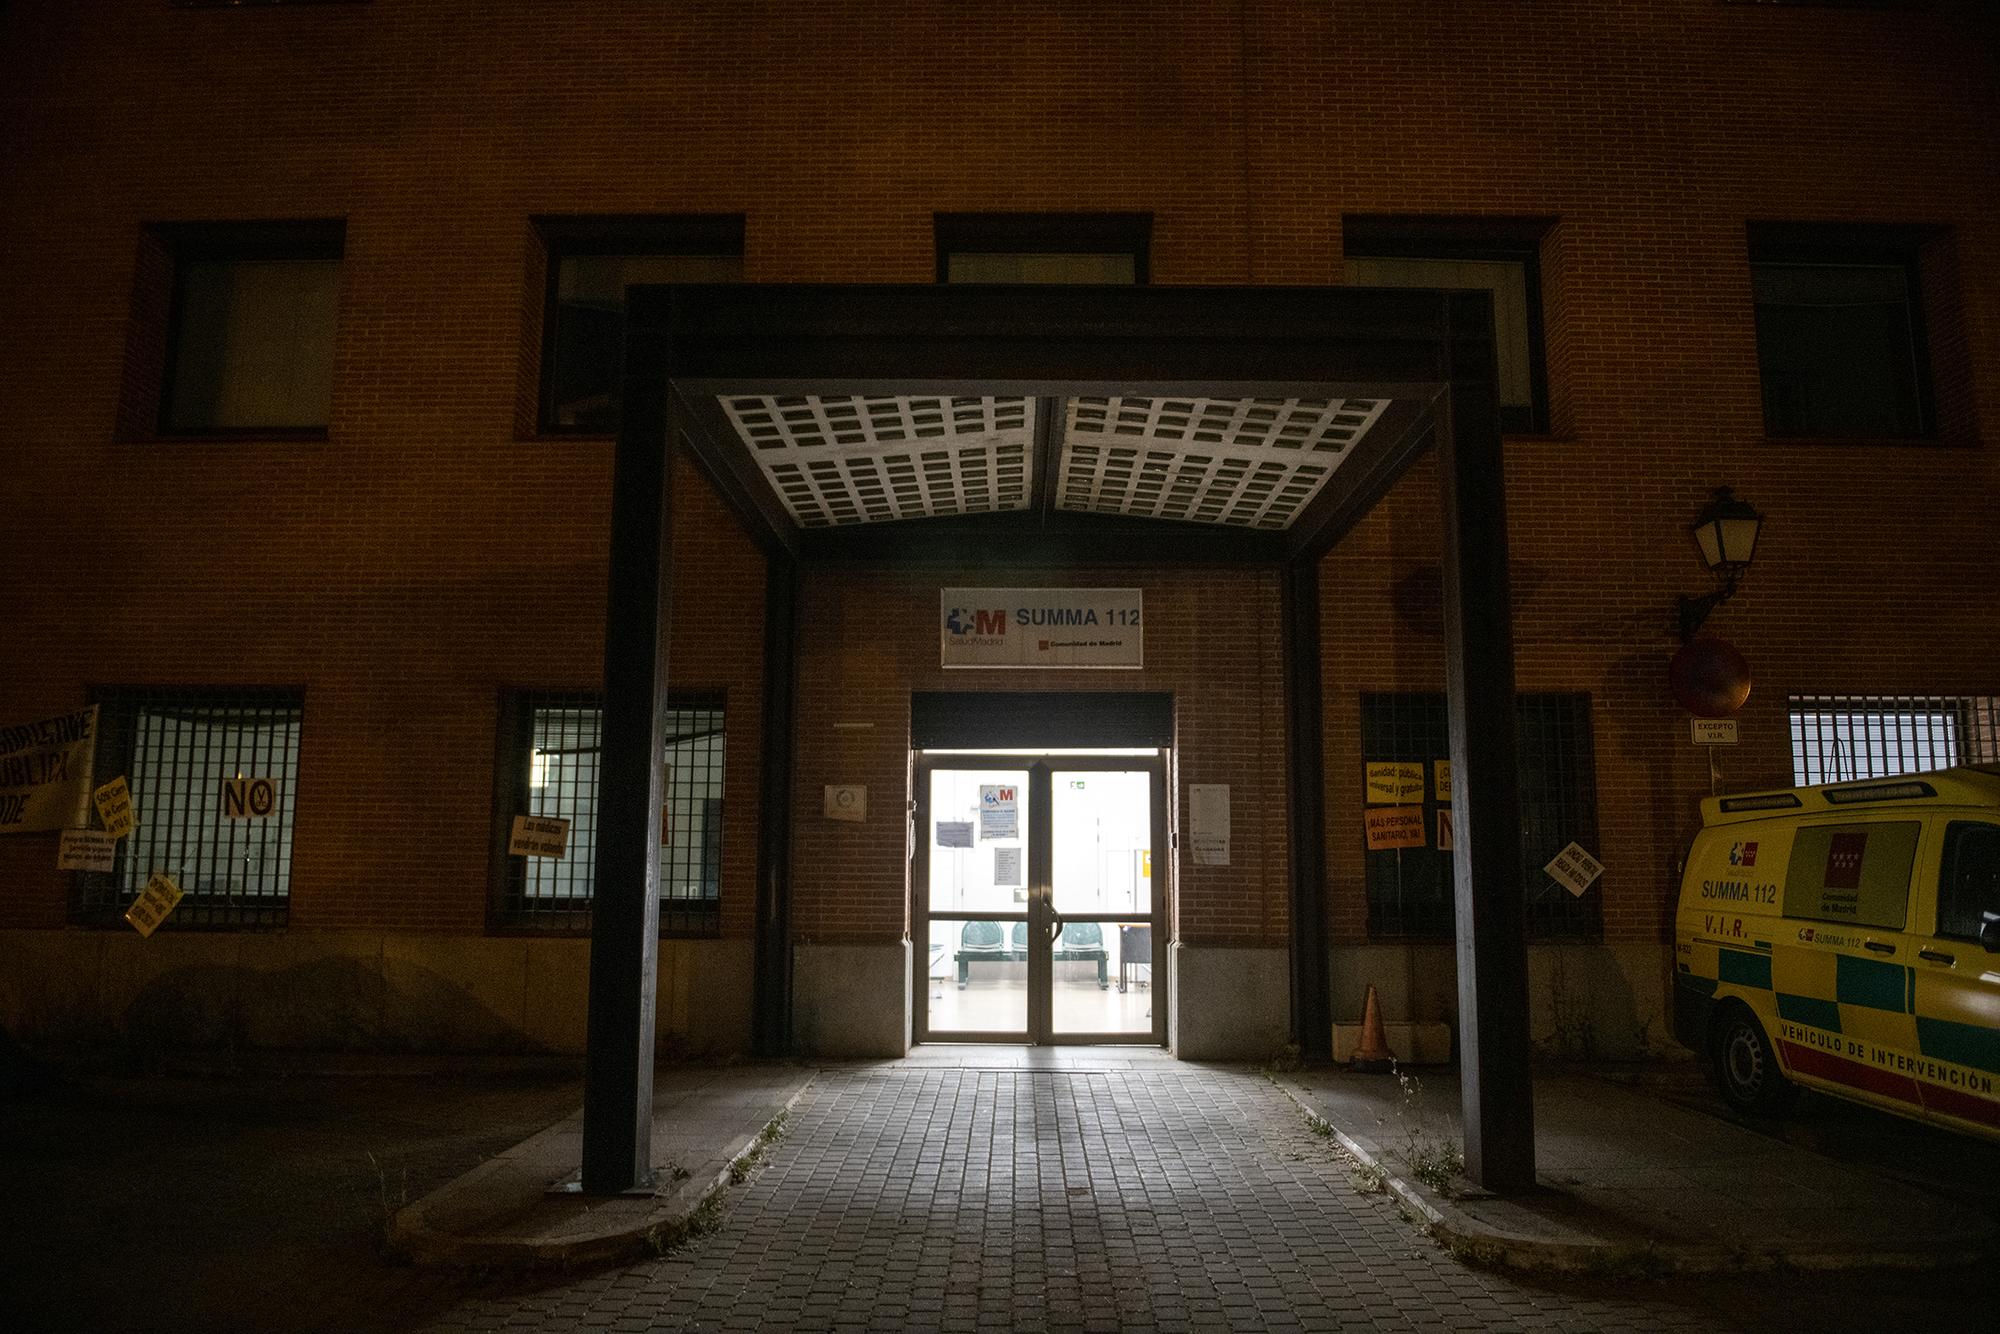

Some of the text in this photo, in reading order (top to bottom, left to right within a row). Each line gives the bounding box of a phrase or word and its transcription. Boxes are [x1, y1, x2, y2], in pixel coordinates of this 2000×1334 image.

[1016, 608, 1140, 626] SUMMA 112
[1050, 640, 1088, 648] Comunidad
[1099, 639, 1122, 647] Madrid
[225, 780, 273, 816] NO
[1386, 815, 1422, 827] PERSONAL
[1439, 811, 1454, 847] N
[1702, 880, 1777, 904] SUMMA 112
[1822, 893, 1858, 903] Comunidad
[1821, 904, 1857, 914] de Madrid
[1705, 915, 1749, 938] V.I.R.
[1814, 933, 1861, 948] SUMMA 112
[1781, 1024, 1992, 1093] VEHÍCULO DE INTERVENCIÓN
